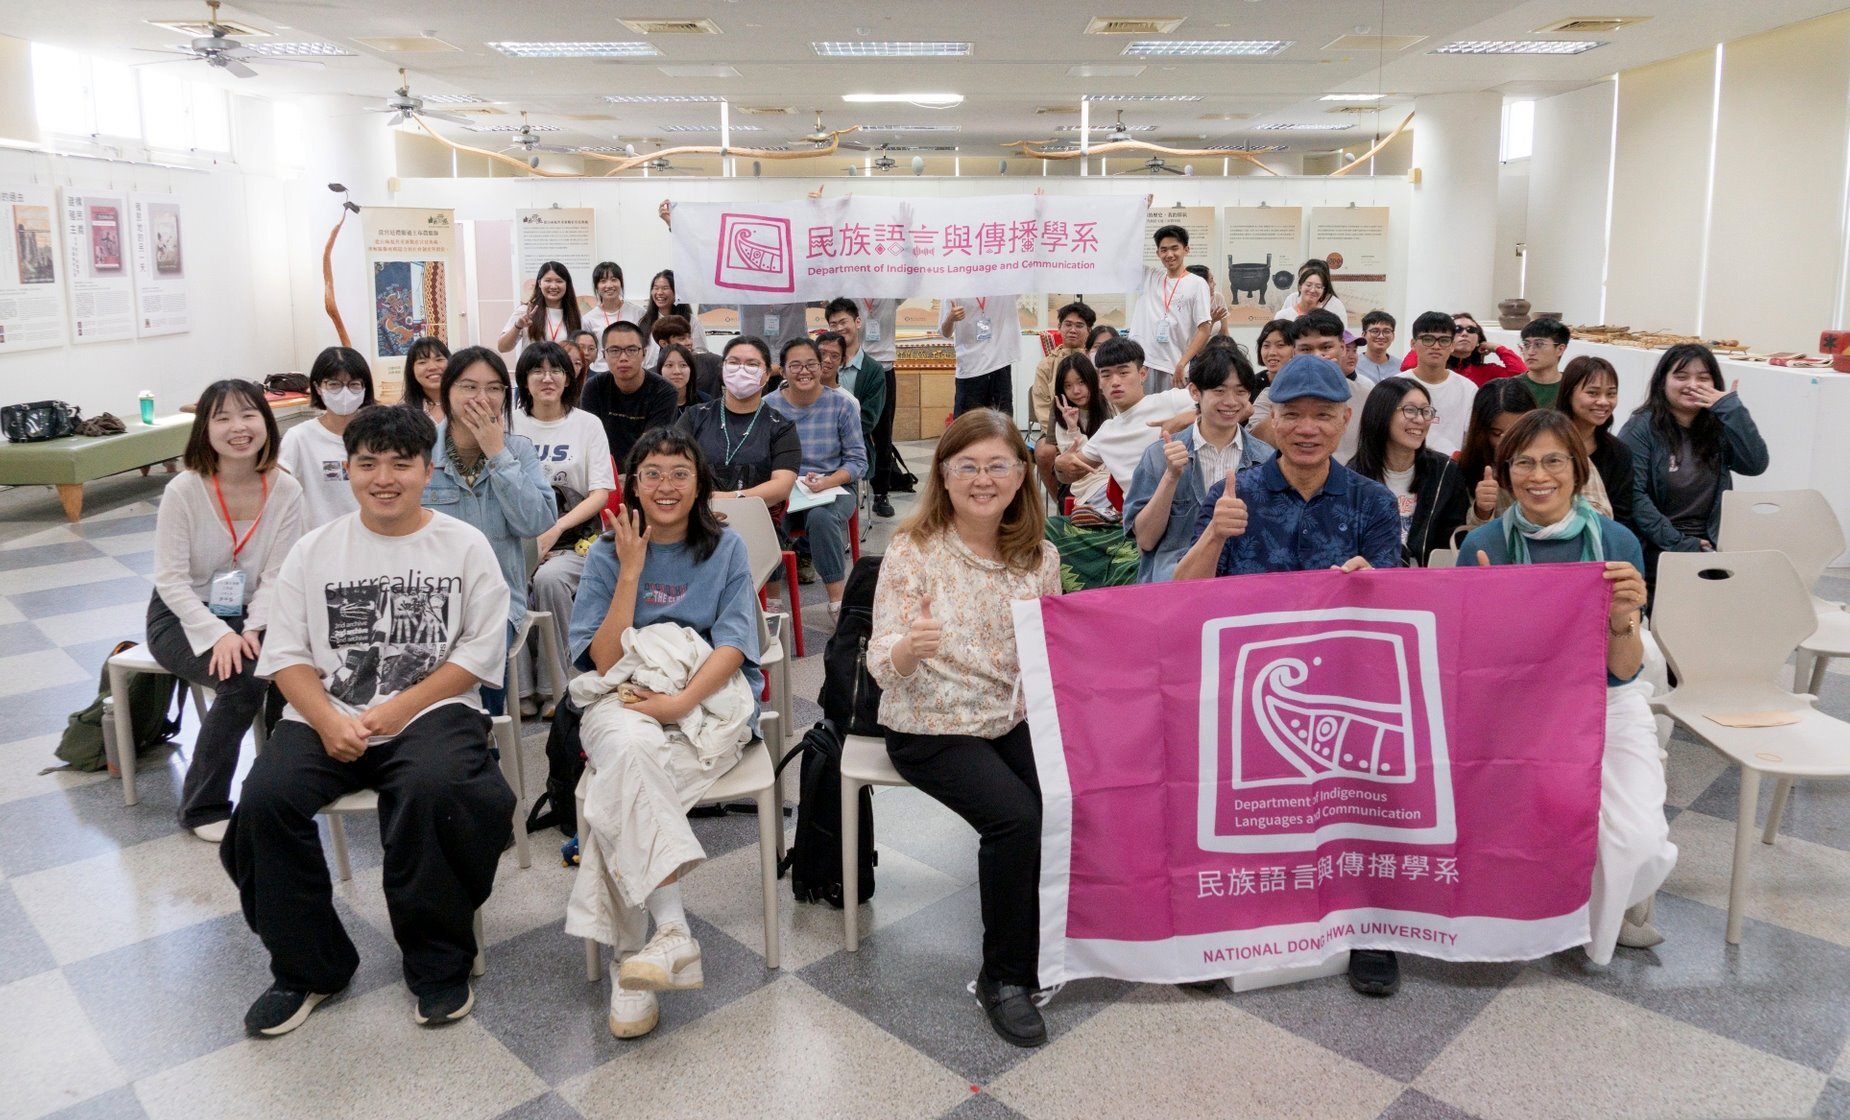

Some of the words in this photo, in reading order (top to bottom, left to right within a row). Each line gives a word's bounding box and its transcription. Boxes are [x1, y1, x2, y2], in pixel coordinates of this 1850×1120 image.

[806, 219, 1098, 260] 民族語言與傳播學系
[808, 264, 871, 276] Department
[873, 264, 885, 273] of
[947, 262, 998, 274] Language
[1000, 260, 1019, 270] and
[325, 569, 462, 600] surrealism
[1234, 797, 1311, 812] Department
[1320, 786, 1388, 803] Indigenous
[1234, 814, 1305, 830] Languages
[1322, 805, 1422, 820] Communication
[1197, 851, 1460, 899] 民族語言與傳播學系
[1203, 942, 1283, 964] NATIONAL
[1287, 934, 1325, 954] DONG
[1326, 922, 1355, 942] HWA
[1360, 922, 1458, 947] UNIVERSITY
